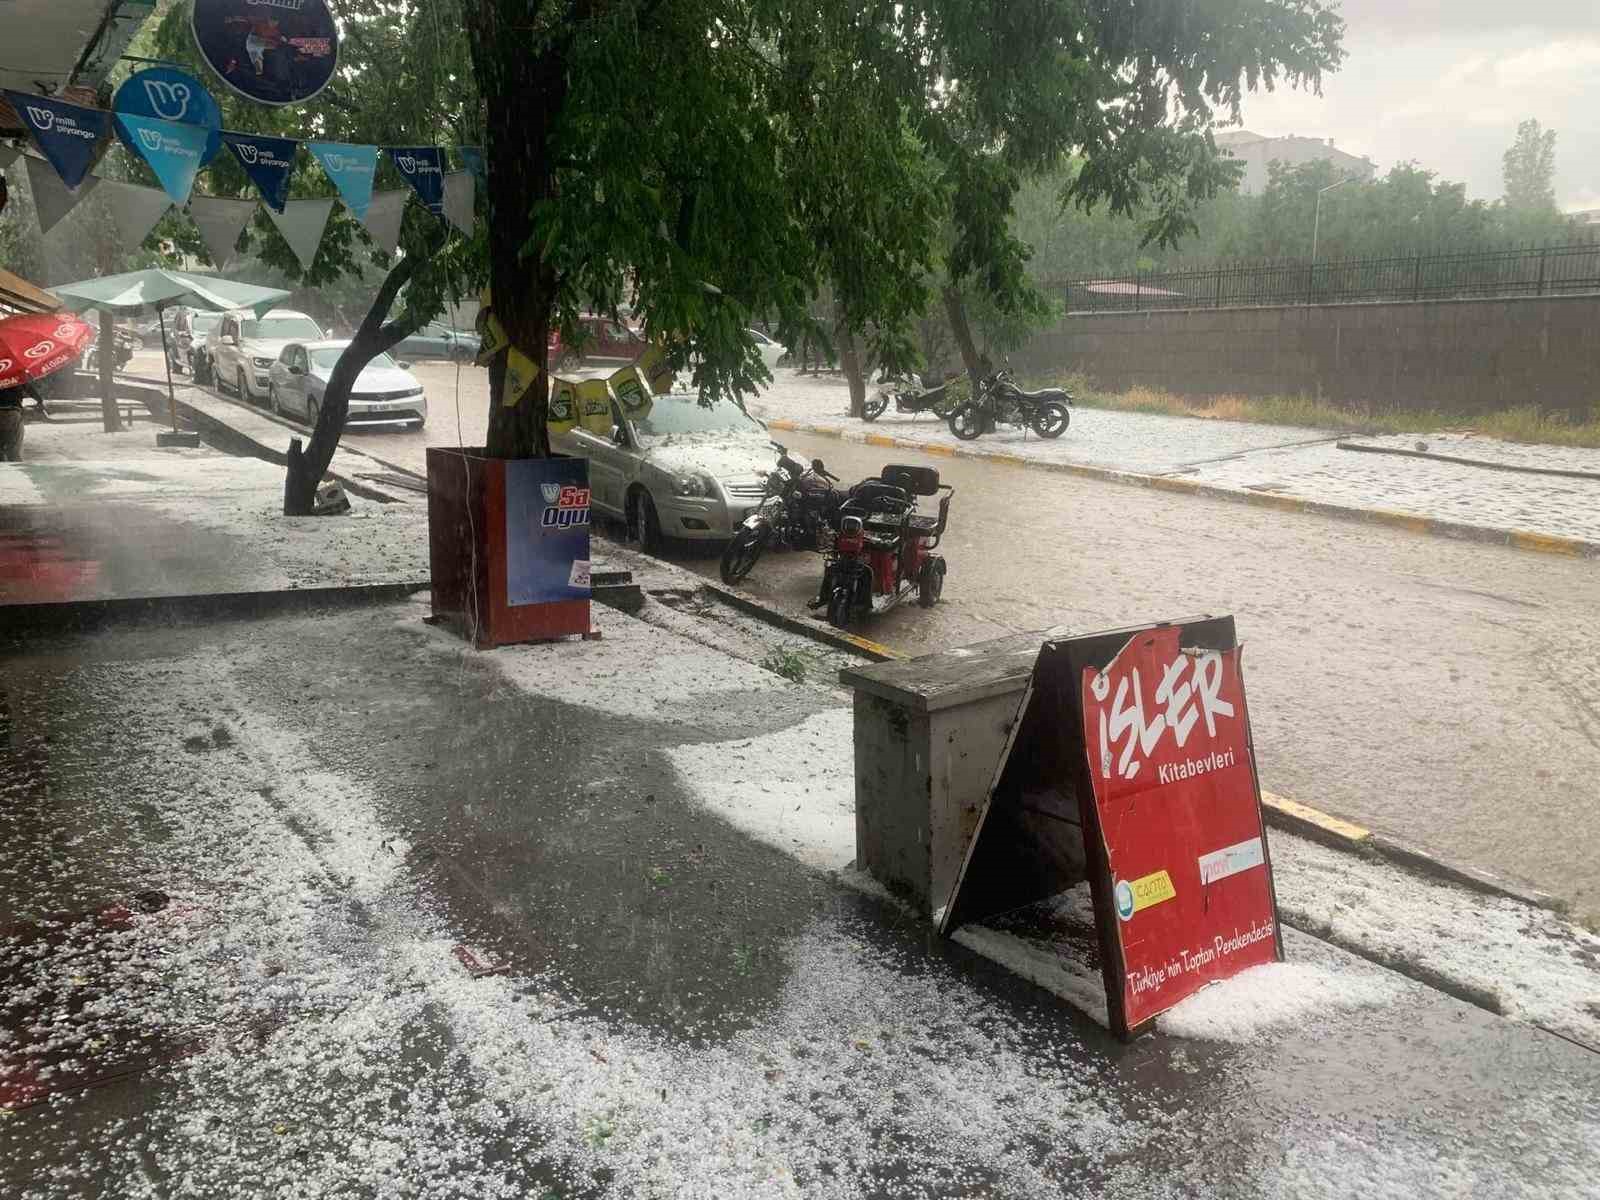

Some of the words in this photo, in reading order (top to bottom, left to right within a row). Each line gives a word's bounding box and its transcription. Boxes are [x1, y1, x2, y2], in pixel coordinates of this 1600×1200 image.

[55, 117, 76, 127] milli
[57, 125, 96, 139] piyango
[260, 158, 290, 168] piyango
[560, 486, 591, 508] Sa
[541, 506, 591, 529] Oyu
[1091, 651, 1234, 780] İŞLER
[1158, 747, 1235, 785] Kitabevleri
[1127, 958, 1182, 995] Türkiye'nin
[1181, 948, 1215, 975] Toptan
[1213, 917, 1275, 959] Perakendecisi
